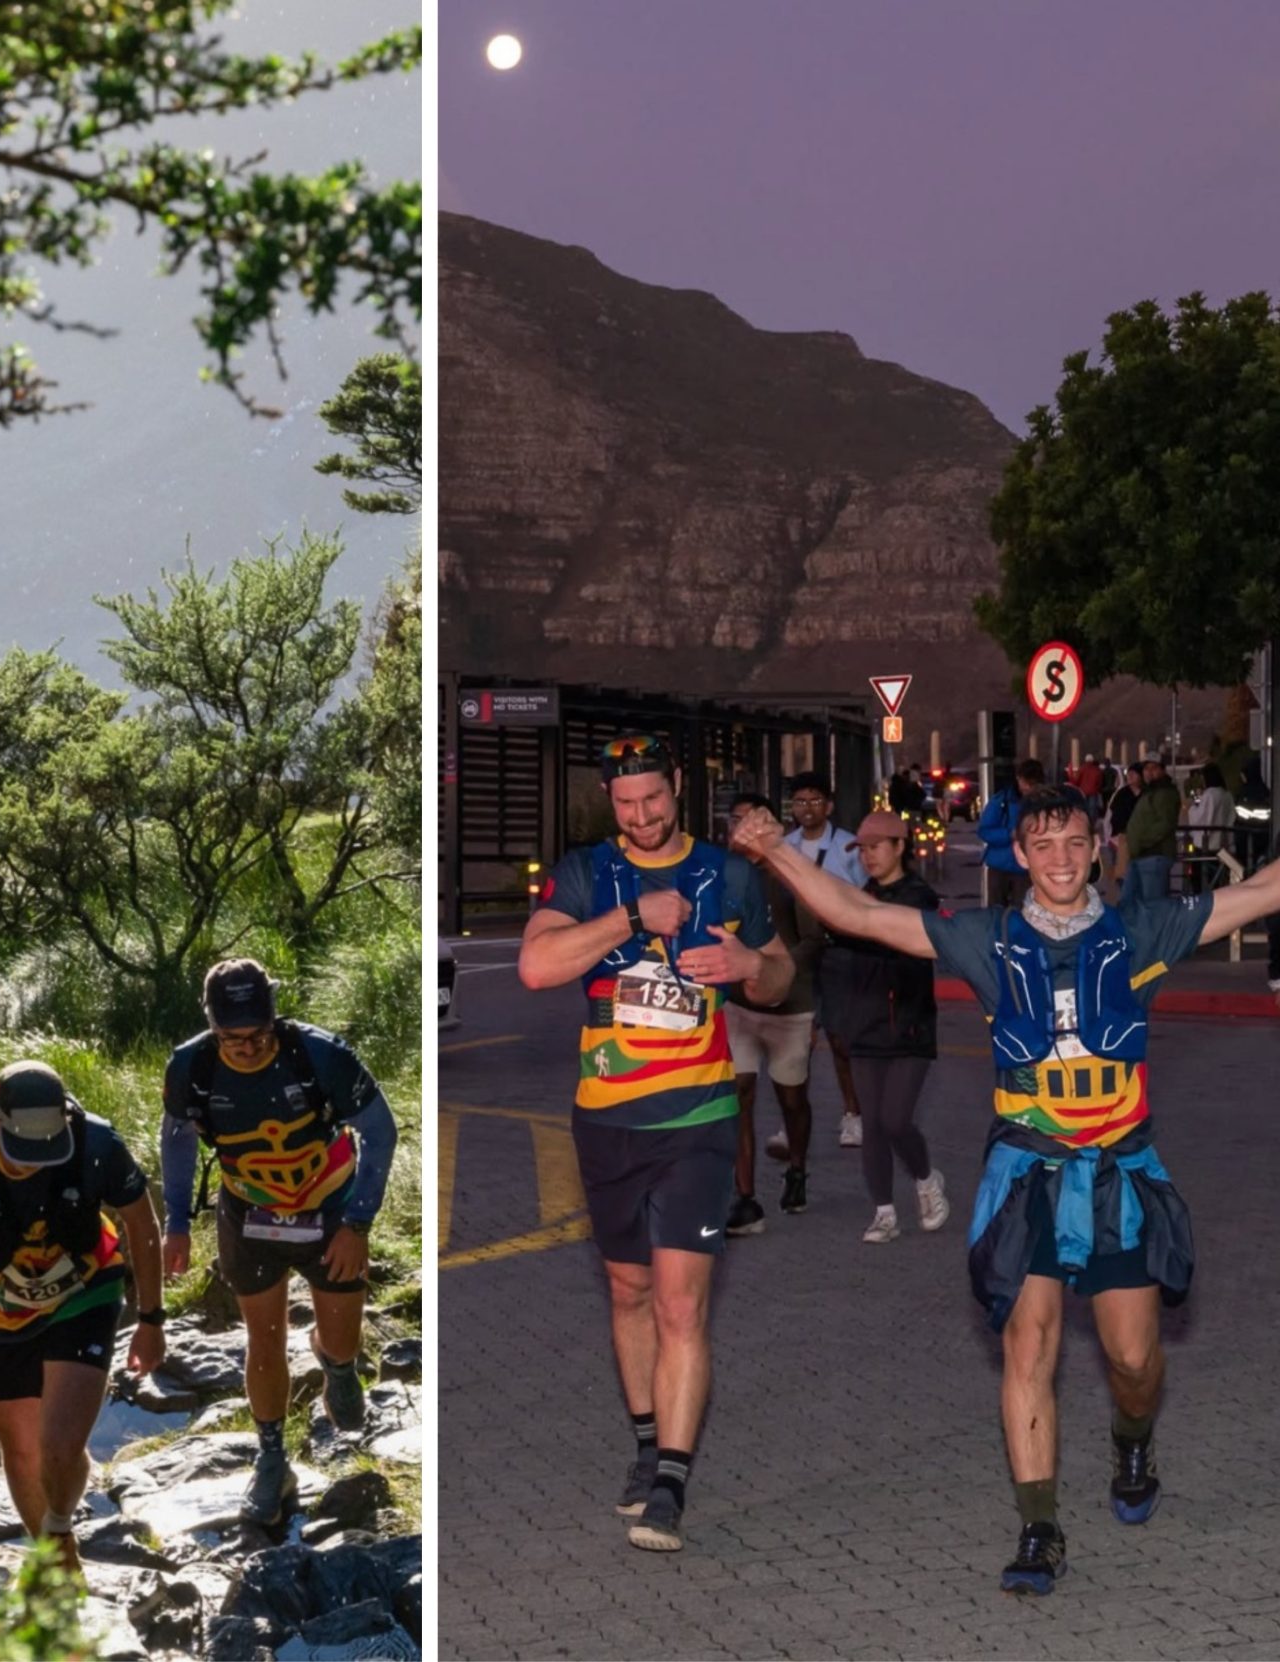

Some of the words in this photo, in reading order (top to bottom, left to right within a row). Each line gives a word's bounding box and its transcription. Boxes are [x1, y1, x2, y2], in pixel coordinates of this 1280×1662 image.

[1042, 660, 1066, 702] S
[639, 981, 681, 1009] 152
[19, 1282, 61, 1300] 120
